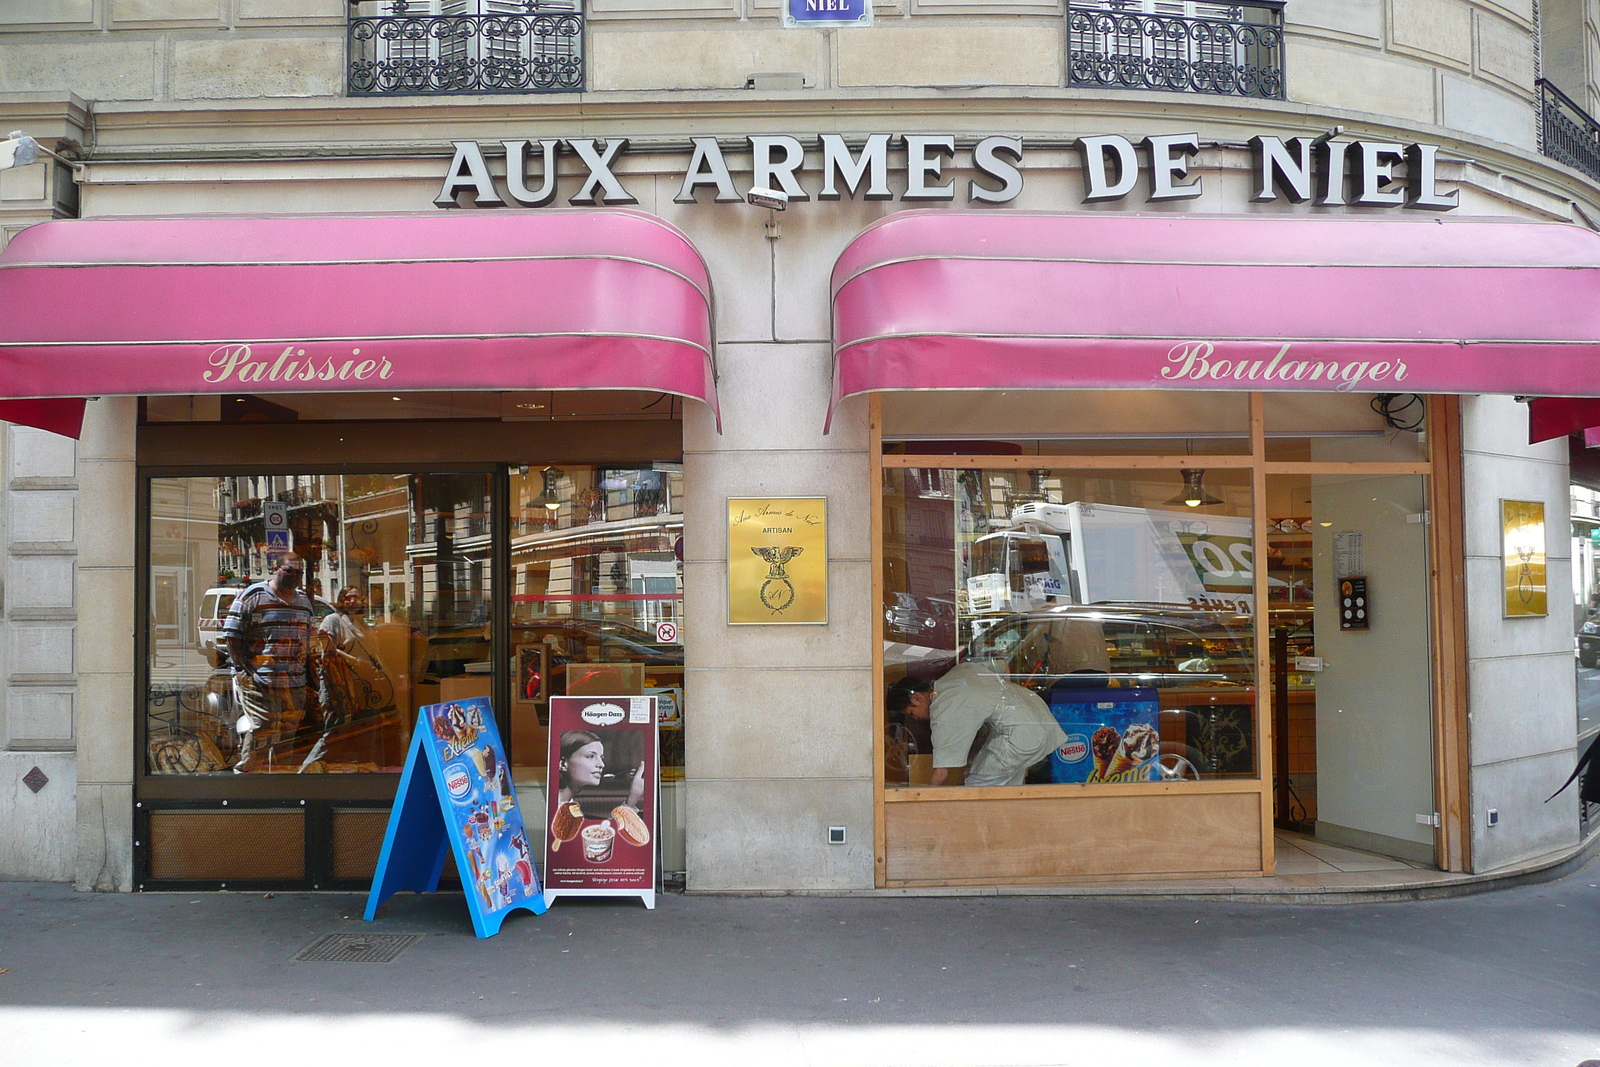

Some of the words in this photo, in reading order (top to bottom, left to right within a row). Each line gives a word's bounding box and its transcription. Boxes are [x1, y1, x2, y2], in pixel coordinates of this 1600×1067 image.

[805, 0, 850, 12] NIEL
[433, 137, 639, 208] AUX
[673, 132, 1026, 210] ARMES
[1073, 132, 1203, 204] DE
[1247, 134, 1460, 211] NIEL
[202, 343, 394, 383] Patissier
[1160, 339, 1409, 393] Boulanger
[1060, 744, 1086, 756] Nestlé
[447, 775, 469, 791] Nestlé
